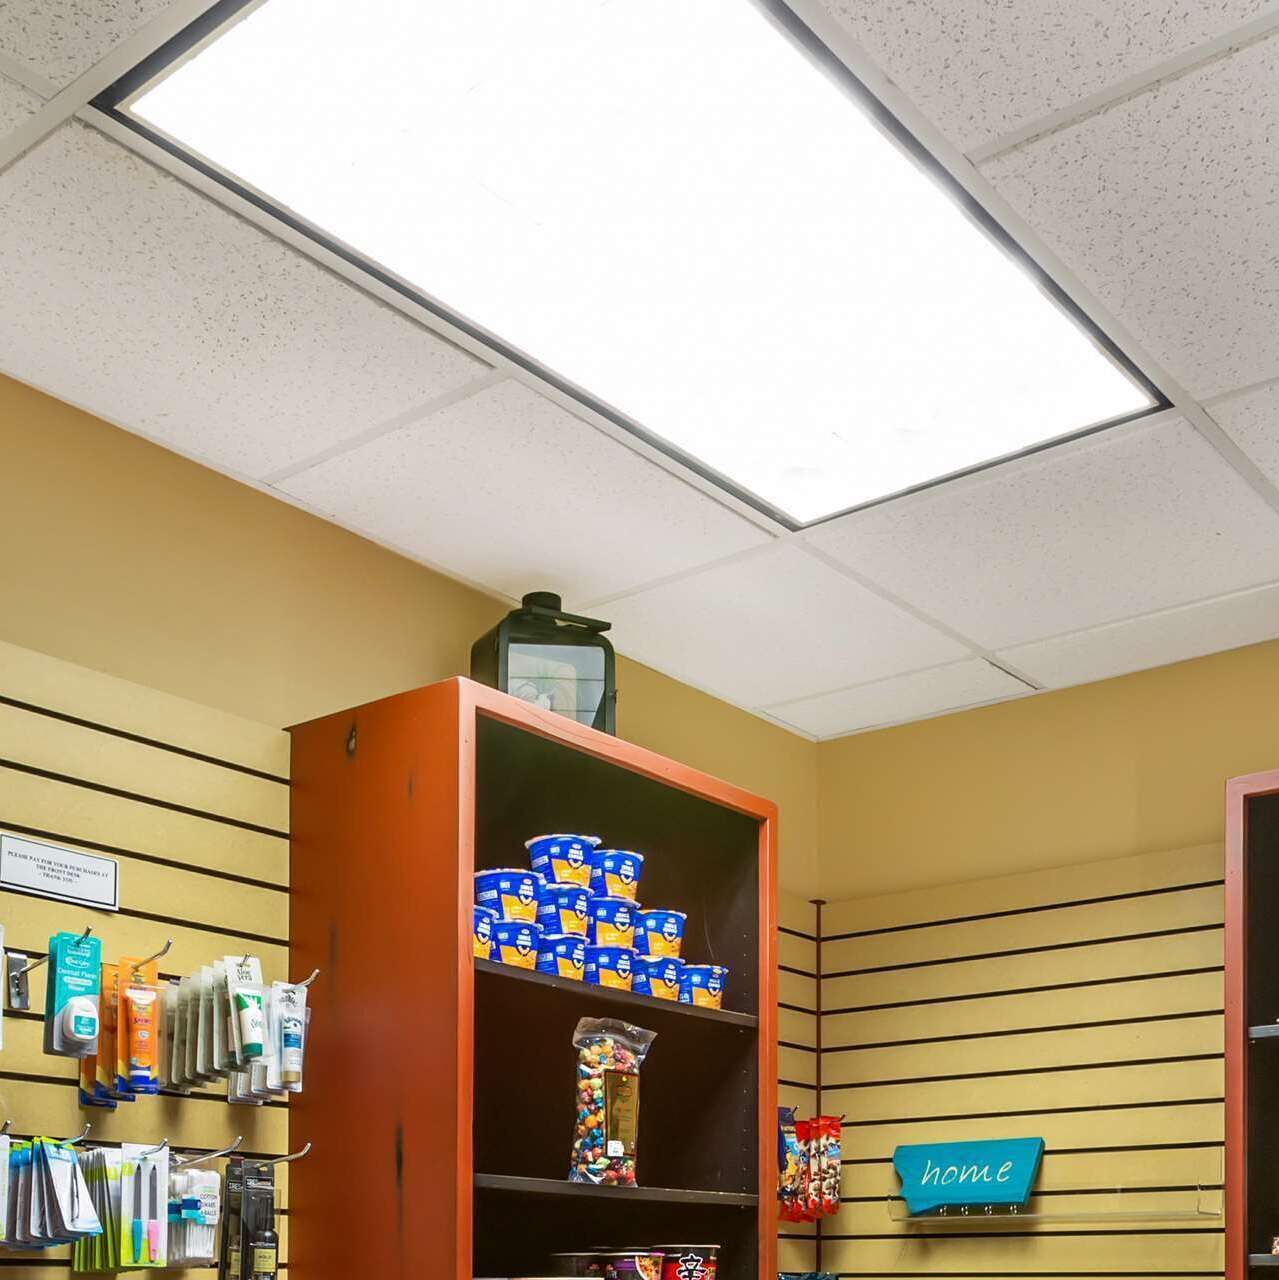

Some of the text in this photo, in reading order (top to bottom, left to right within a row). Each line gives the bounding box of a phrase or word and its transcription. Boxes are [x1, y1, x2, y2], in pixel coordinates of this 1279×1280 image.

[8, 850, 28, 860] PLEASE
[29, 855, 40, 863] PAY
[41, 858, 52, 866] FOR
[53, 861, 68, 869] YOUR
[48, 866, 66, 875] FRONT
[67, 870, 80, 878] DESK
[921, 1159, 1014, 1186] home
